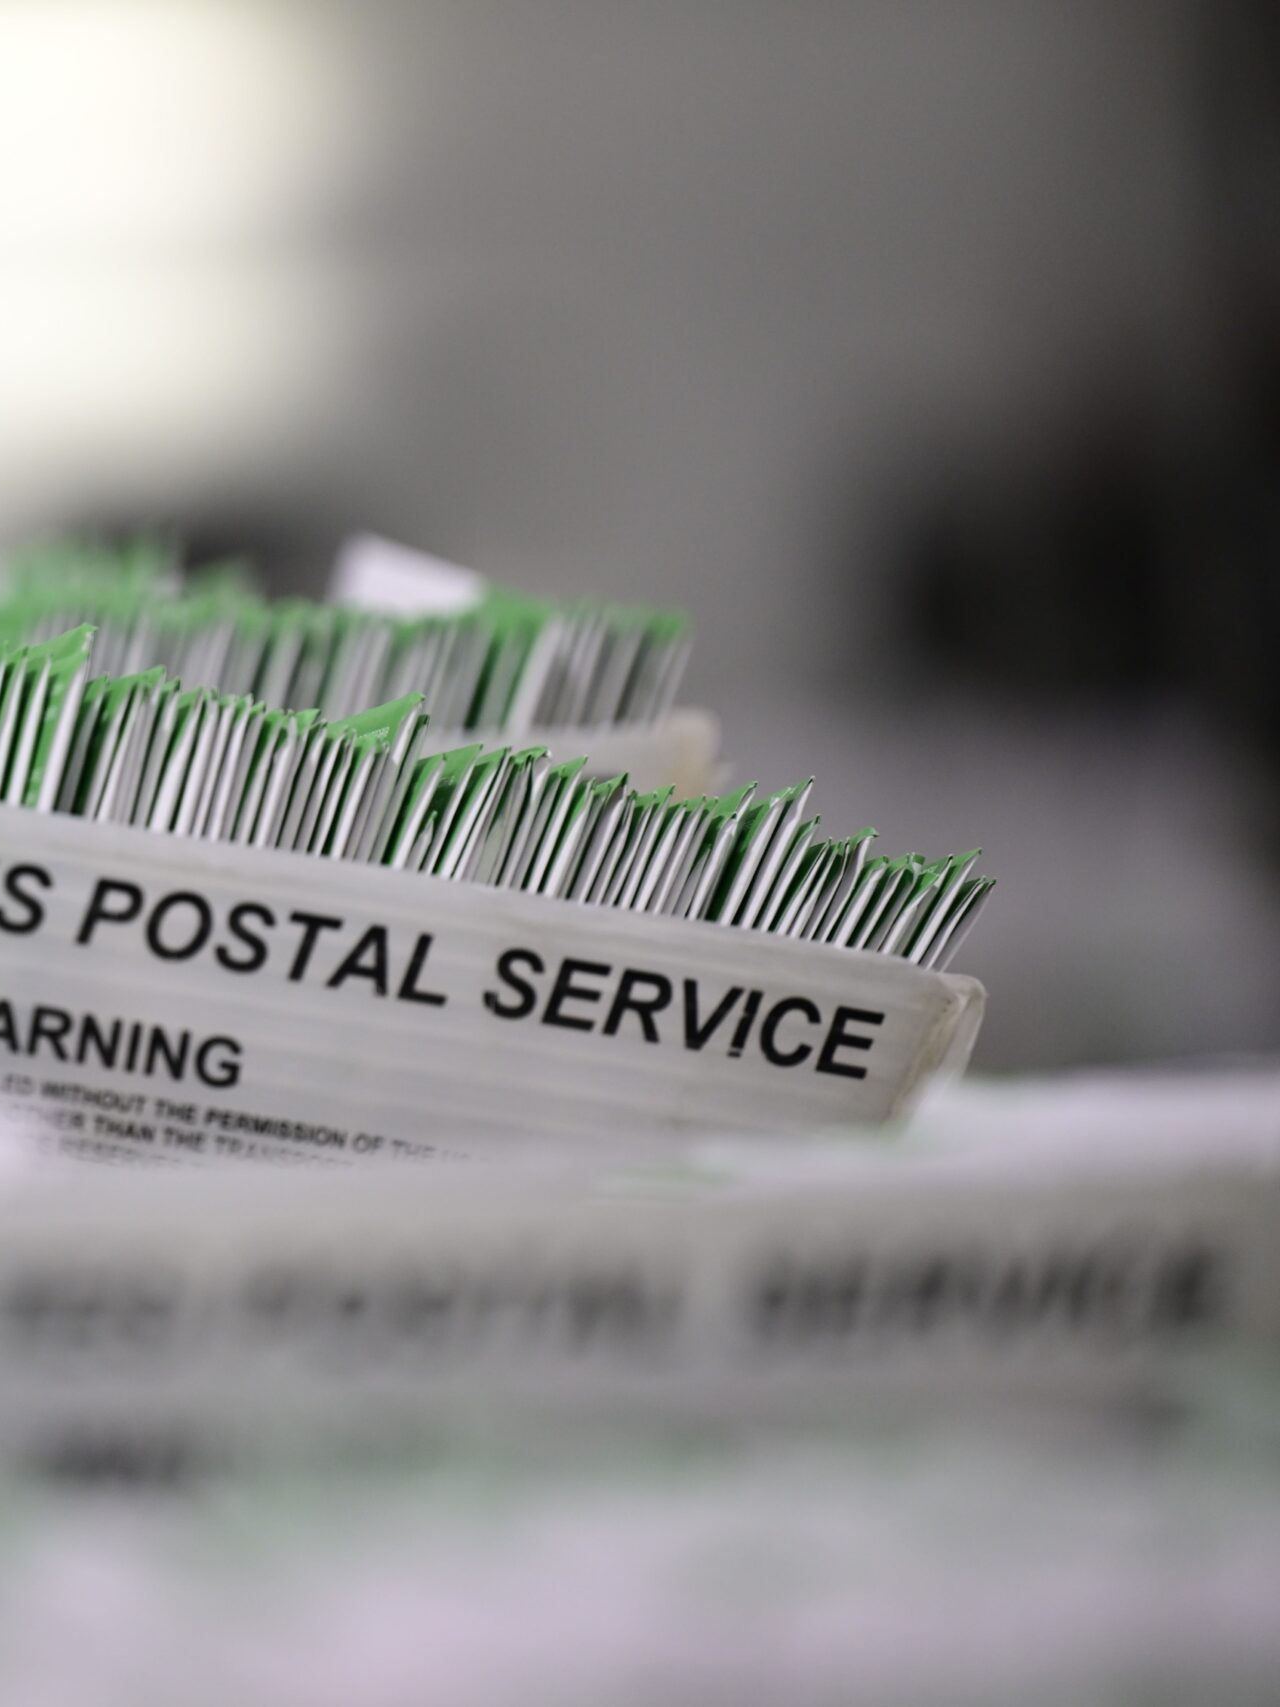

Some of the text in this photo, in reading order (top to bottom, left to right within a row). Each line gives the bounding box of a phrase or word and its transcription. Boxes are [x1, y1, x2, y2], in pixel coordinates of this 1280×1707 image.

[74, 878, 451, 1008] POSTAL
[482, 947, 887, 1081] SERVICE
[41, 1082, 146, 1115] WITHOUT
[154, 1098, 198, 1125] THE
[205, 1108, 348, 1150] PERMISSION
[352, 1133, 387, 1156] OF
[390, 1139, 437, 1164] THE
[93, 1116, 155, 1144] THAN
[164, 1128, 206, 1154] THE
